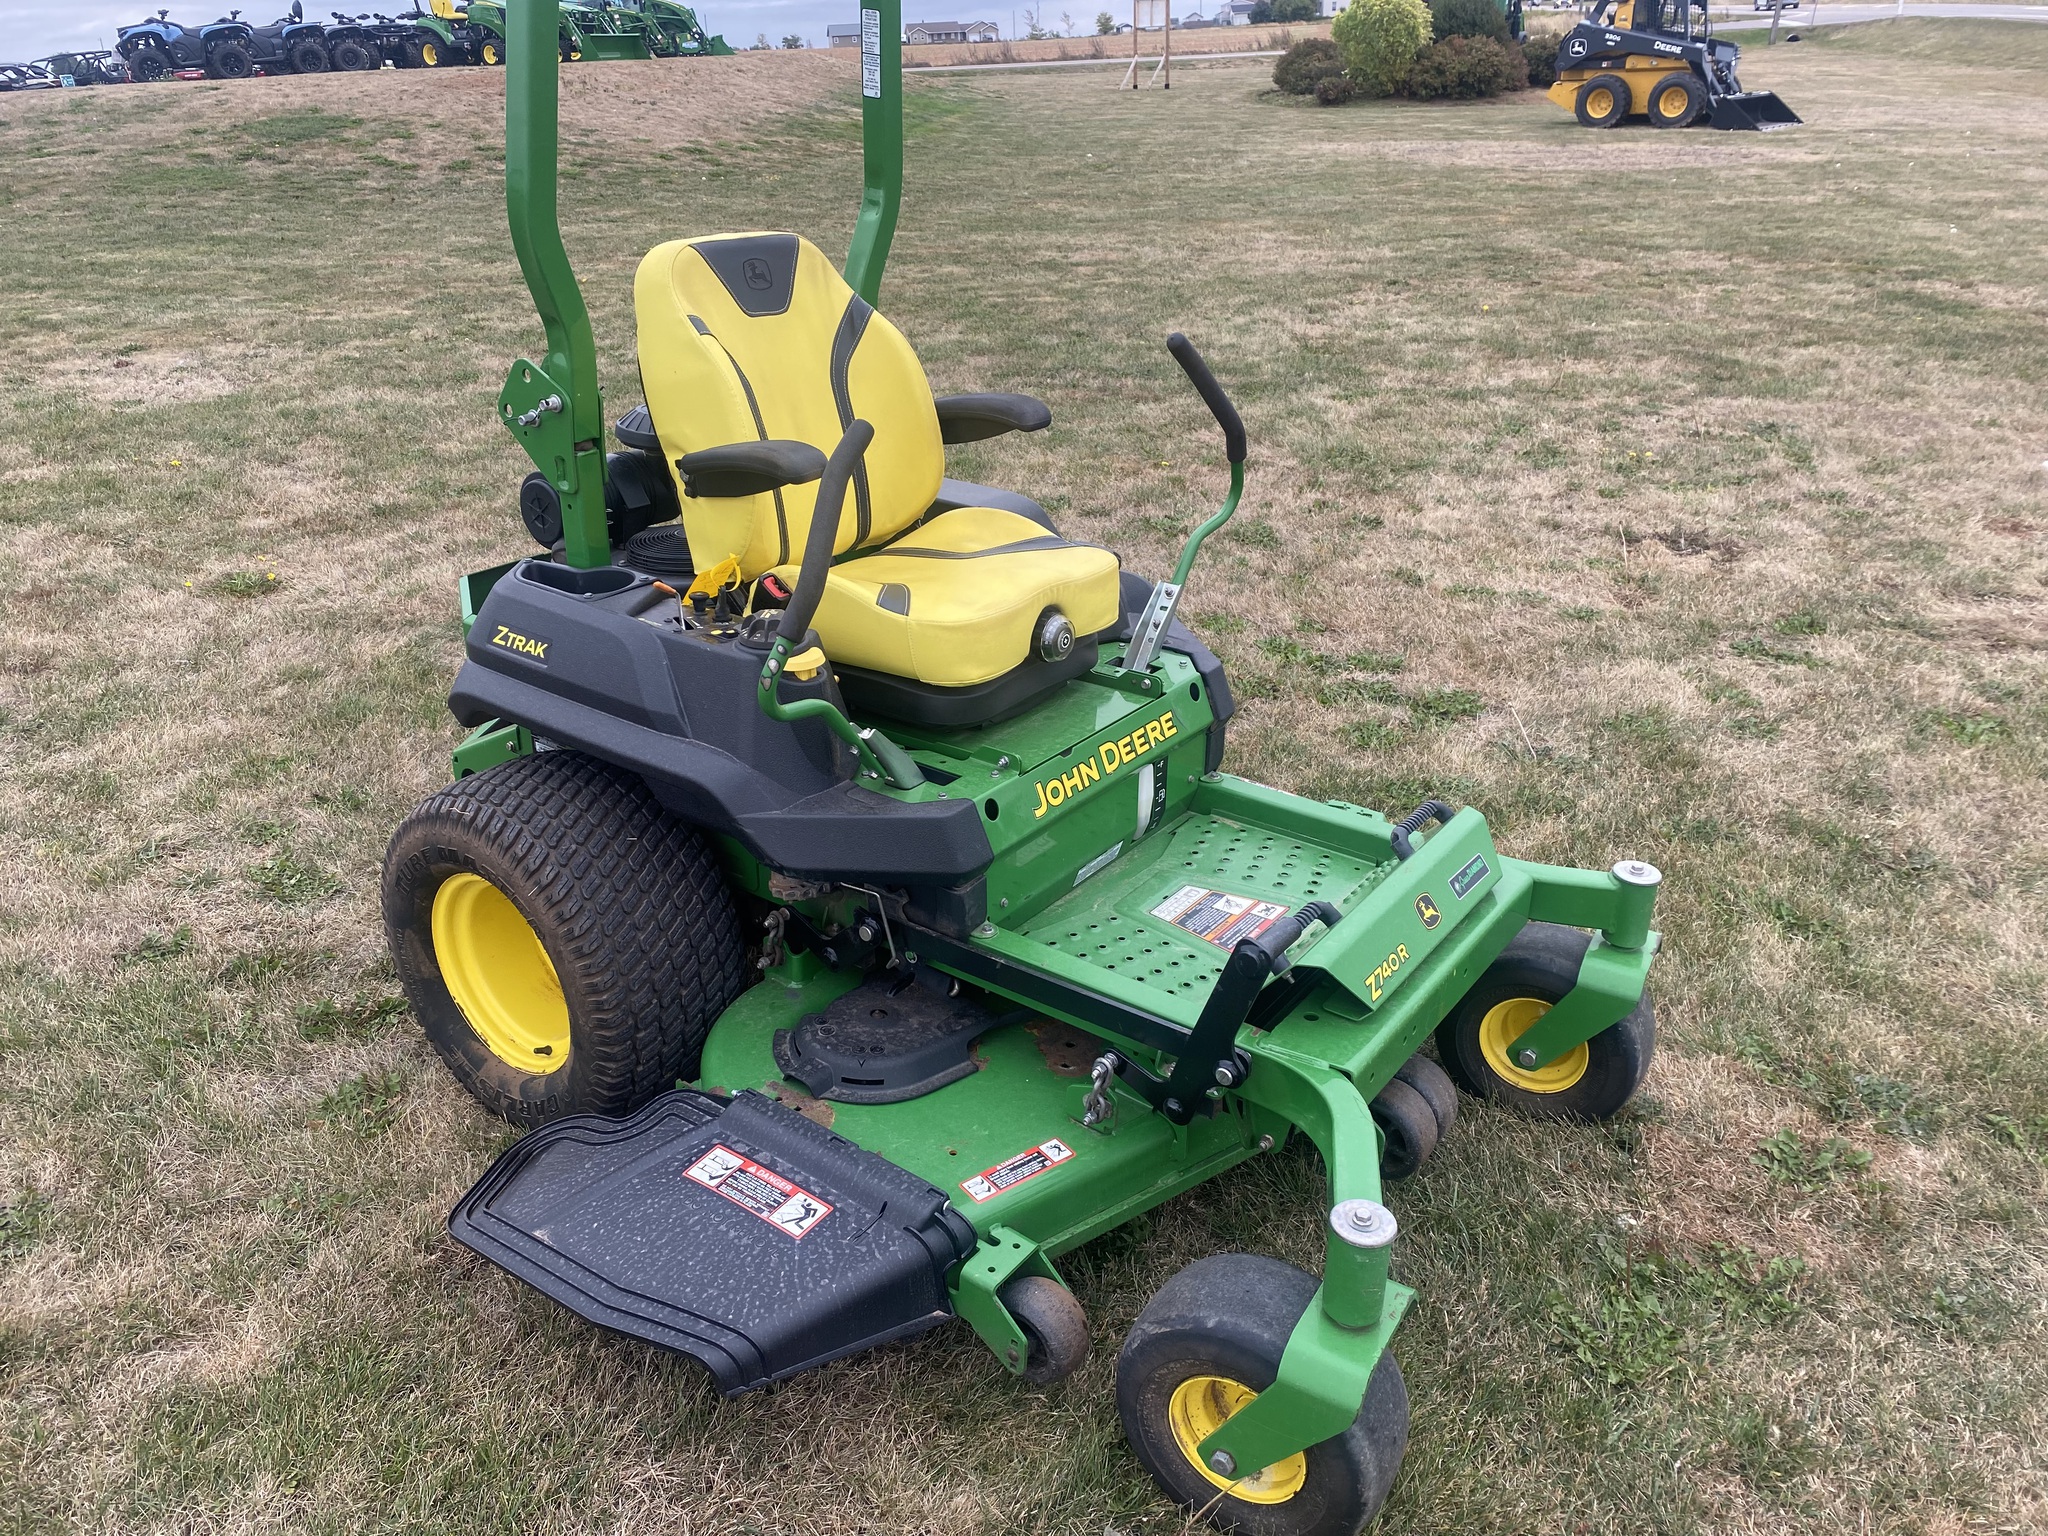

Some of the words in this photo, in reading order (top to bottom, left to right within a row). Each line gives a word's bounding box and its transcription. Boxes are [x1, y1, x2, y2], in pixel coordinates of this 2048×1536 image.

[1653, 41, 1683, 54] DEERE
[492, 625, 549, 659] ZTRAK
[1032, 756, 1101, 820] JOHN
[1098, 710, 1179, 775] DEERE
[394, 845, 432, 897] TURF
[1000, 1152, 1027, 1168] DANGER
[755, 1168, 794, 1193] DANGER
